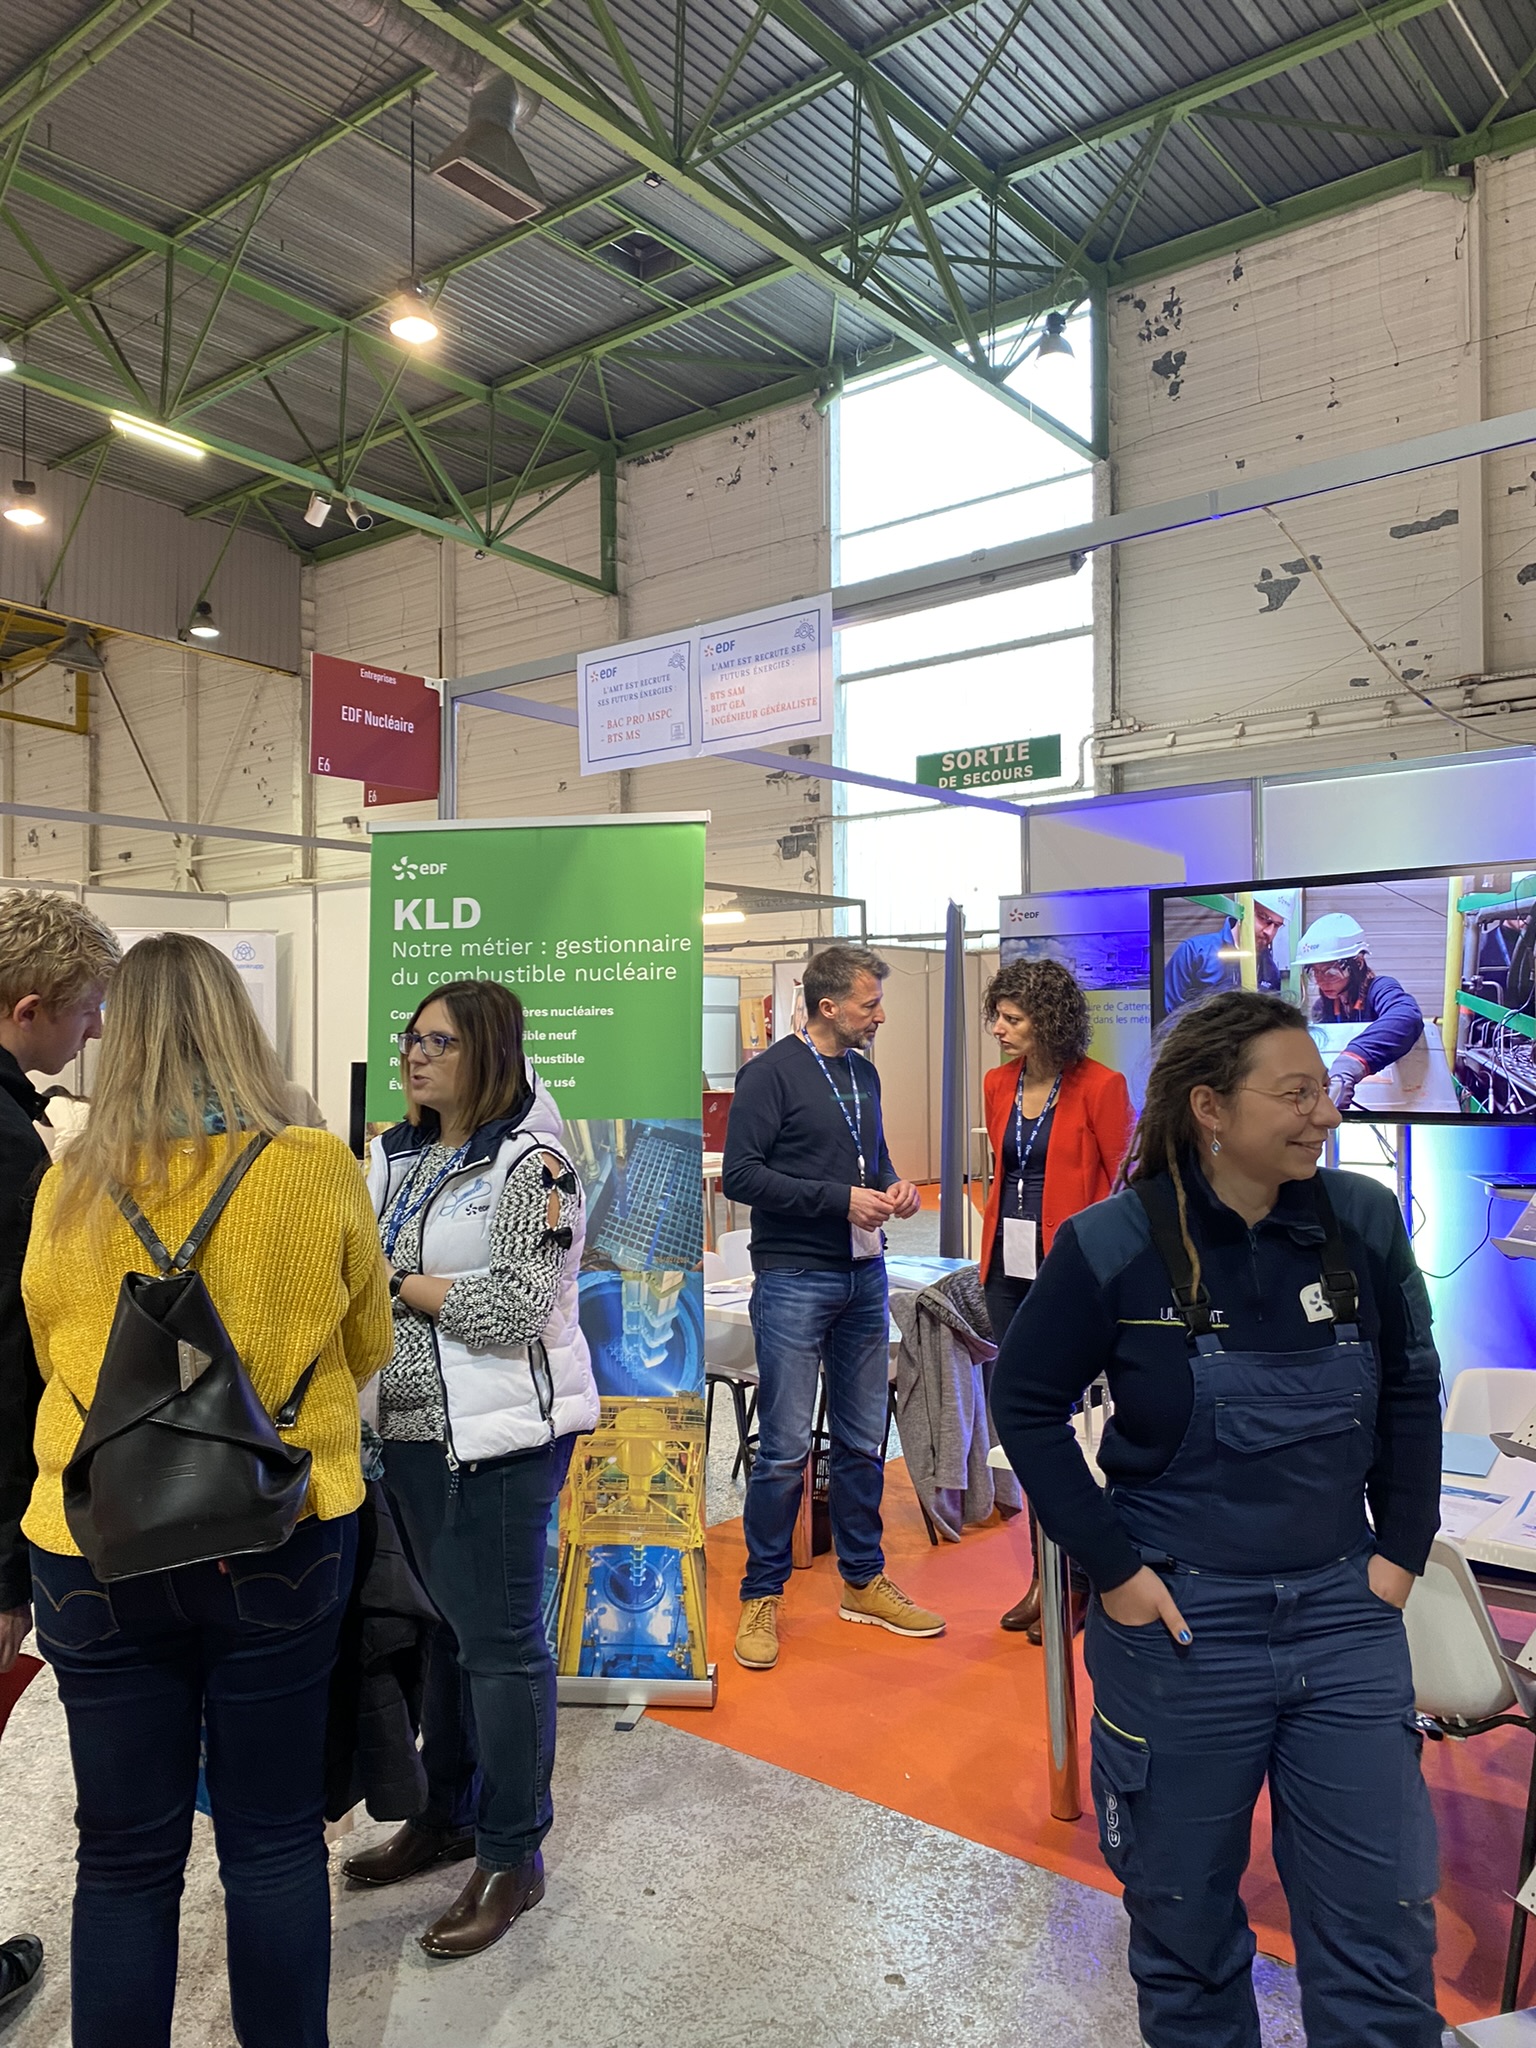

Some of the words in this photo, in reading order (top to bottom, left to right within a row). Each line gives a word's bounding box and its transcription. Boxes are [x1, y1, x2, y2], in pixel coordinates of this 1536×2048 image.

[711, 660, 735, 671] L'AMT
[737, 656, 752, 666] EST
[754, 647, 789, 662] RECRUTE
[791, 643, 806, 653] SES
[360, 668, 397, 685] Entreprises
[720, 669, 750, 682] FUTURS
[753, 659, 790, 675] ÉNERGIES
[603, 684, 623, 695] L'AMT
[625, 681, 638, 690] EST
[640, 674, 670, 687] RECRUTE
[710, 690, 726, 701] BTS
[727, 686, 745, 697] SAM
[597, 698, 610, 707] SES
[611, 693, 639, 705] FUTURS
[640, 685, 673, 699] ÉNERGIES
[711, 702, 728, 714] BUT
[729, 699, 746, 709] GEA
[711, 709, 758, 726] INGÉNIEUR
[760, 697, 818, 717] GÉNÉRALISTE
[341, 705, 362, 723] EDF
[364, 710, 414, 733] Nucléaire
[607, 717, 624, 730] BAC
[626, 714, 645, 727] PRO
[647, 708, 673, 723] MSPC
[607, 732, 623, 744] BTS
[626, 730, 641, 741] MS
[317, 756, 331, 772] E6
[942, 742, 1030, 772] SORTIE
[939, 776, 957, 789] DE
[963, 765, 1033, 786] SECOURS
[368, 790, 377, 803] E6
[393, 897, 482, 931] KLD
[392, 941, 453, 958] Notre
[461, 938, 532, 957] métier
[555, 934, 692, 959] gestionnaire
[391, 966, 421, 986] du
[427, 964, 566, 985] combustible
[575, 962, 677, 982] nucléaire
[522, 1006, 548, 1018] ères
[550, 1005, 614, 1017] nucléaires
[1103, 1002, 1114, 1011] de
[1093, 1015, 1113, 1024] dans
[1116, 1015, 1128, 1024] les
[548, 1029, 577, 1041] neuf
[527, 1053, 585, 1064] bustible
[554, 1076, 576, 1088] usé
